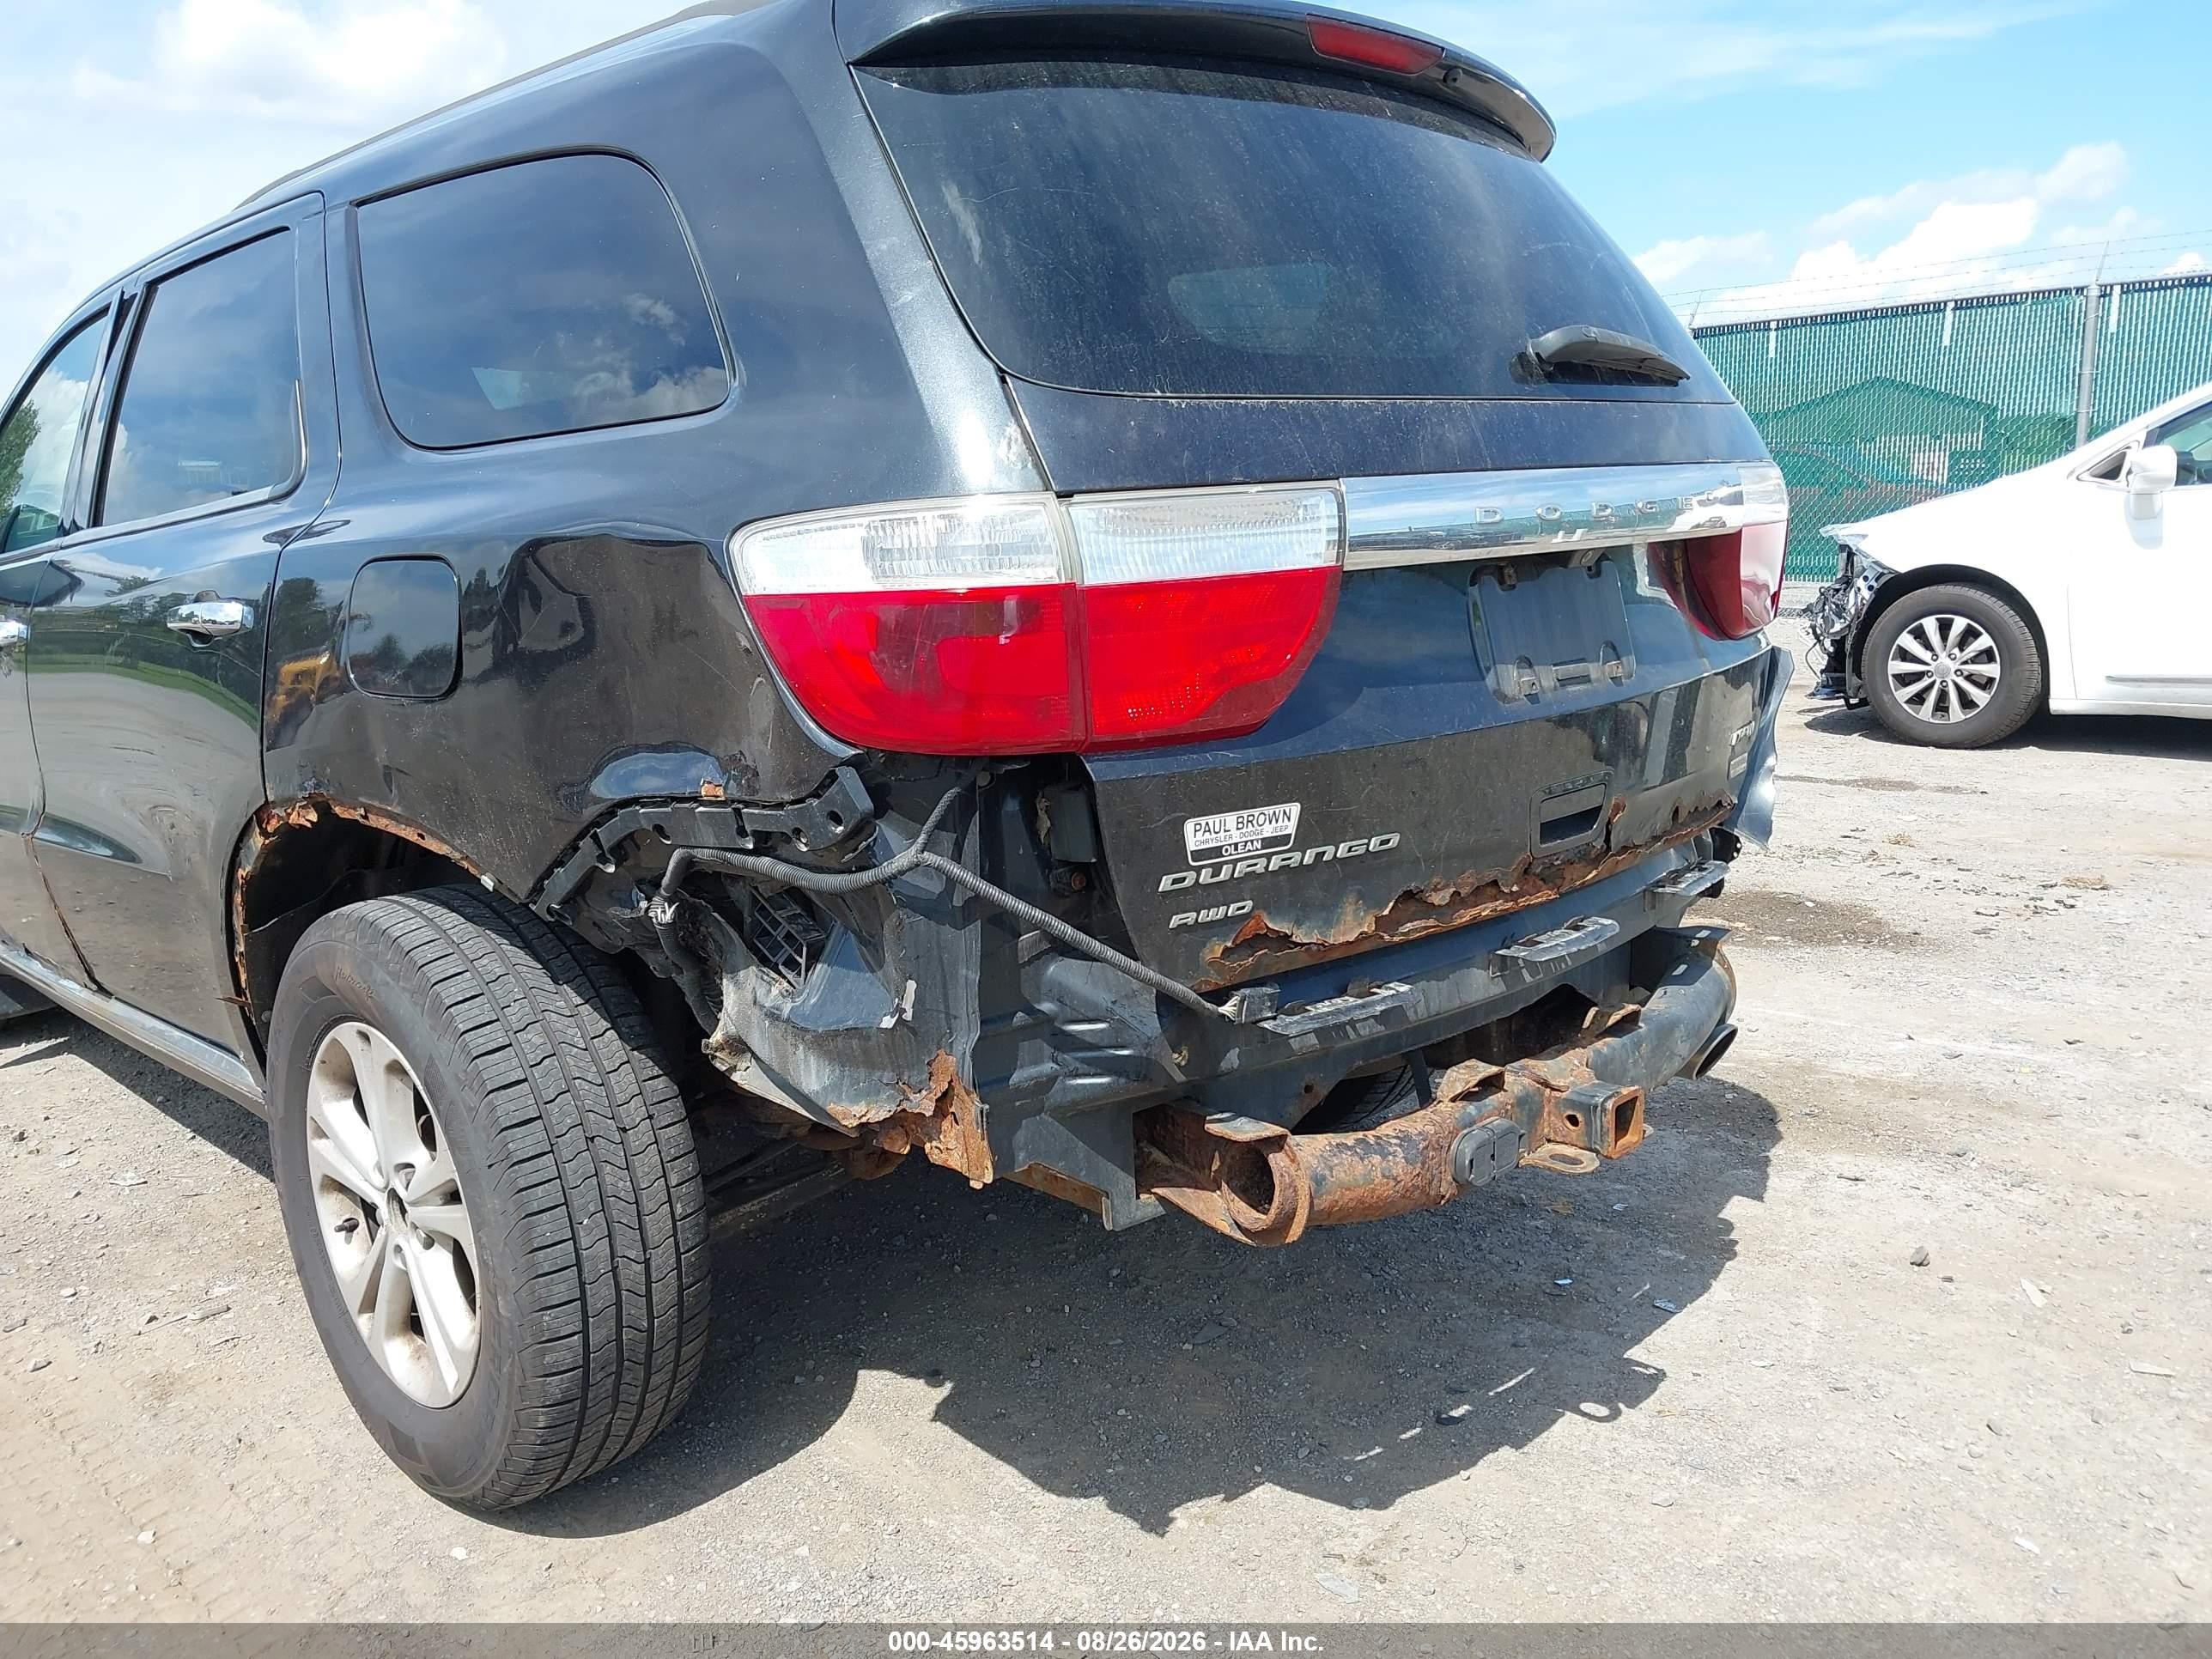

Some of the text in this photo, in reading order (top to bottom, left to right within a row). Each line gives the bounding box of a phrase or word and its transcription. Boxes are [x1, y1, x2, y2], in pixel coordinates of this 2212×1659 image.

[1475, 496, 1693, 523] DODGE
[1194, 807, 1291, 839] PAUL BROWN
[1194, 834, 1233, 848] CHRYSLER
[1239, 829, 1264, 839] DODGE
[1271, 824, 1289, 834] JEEP
[1221, 839, 1261, 856] OLEAN
[1158, 833, 1401, 893] DURANGO
[1168, 900, 1254, 929] AWD
